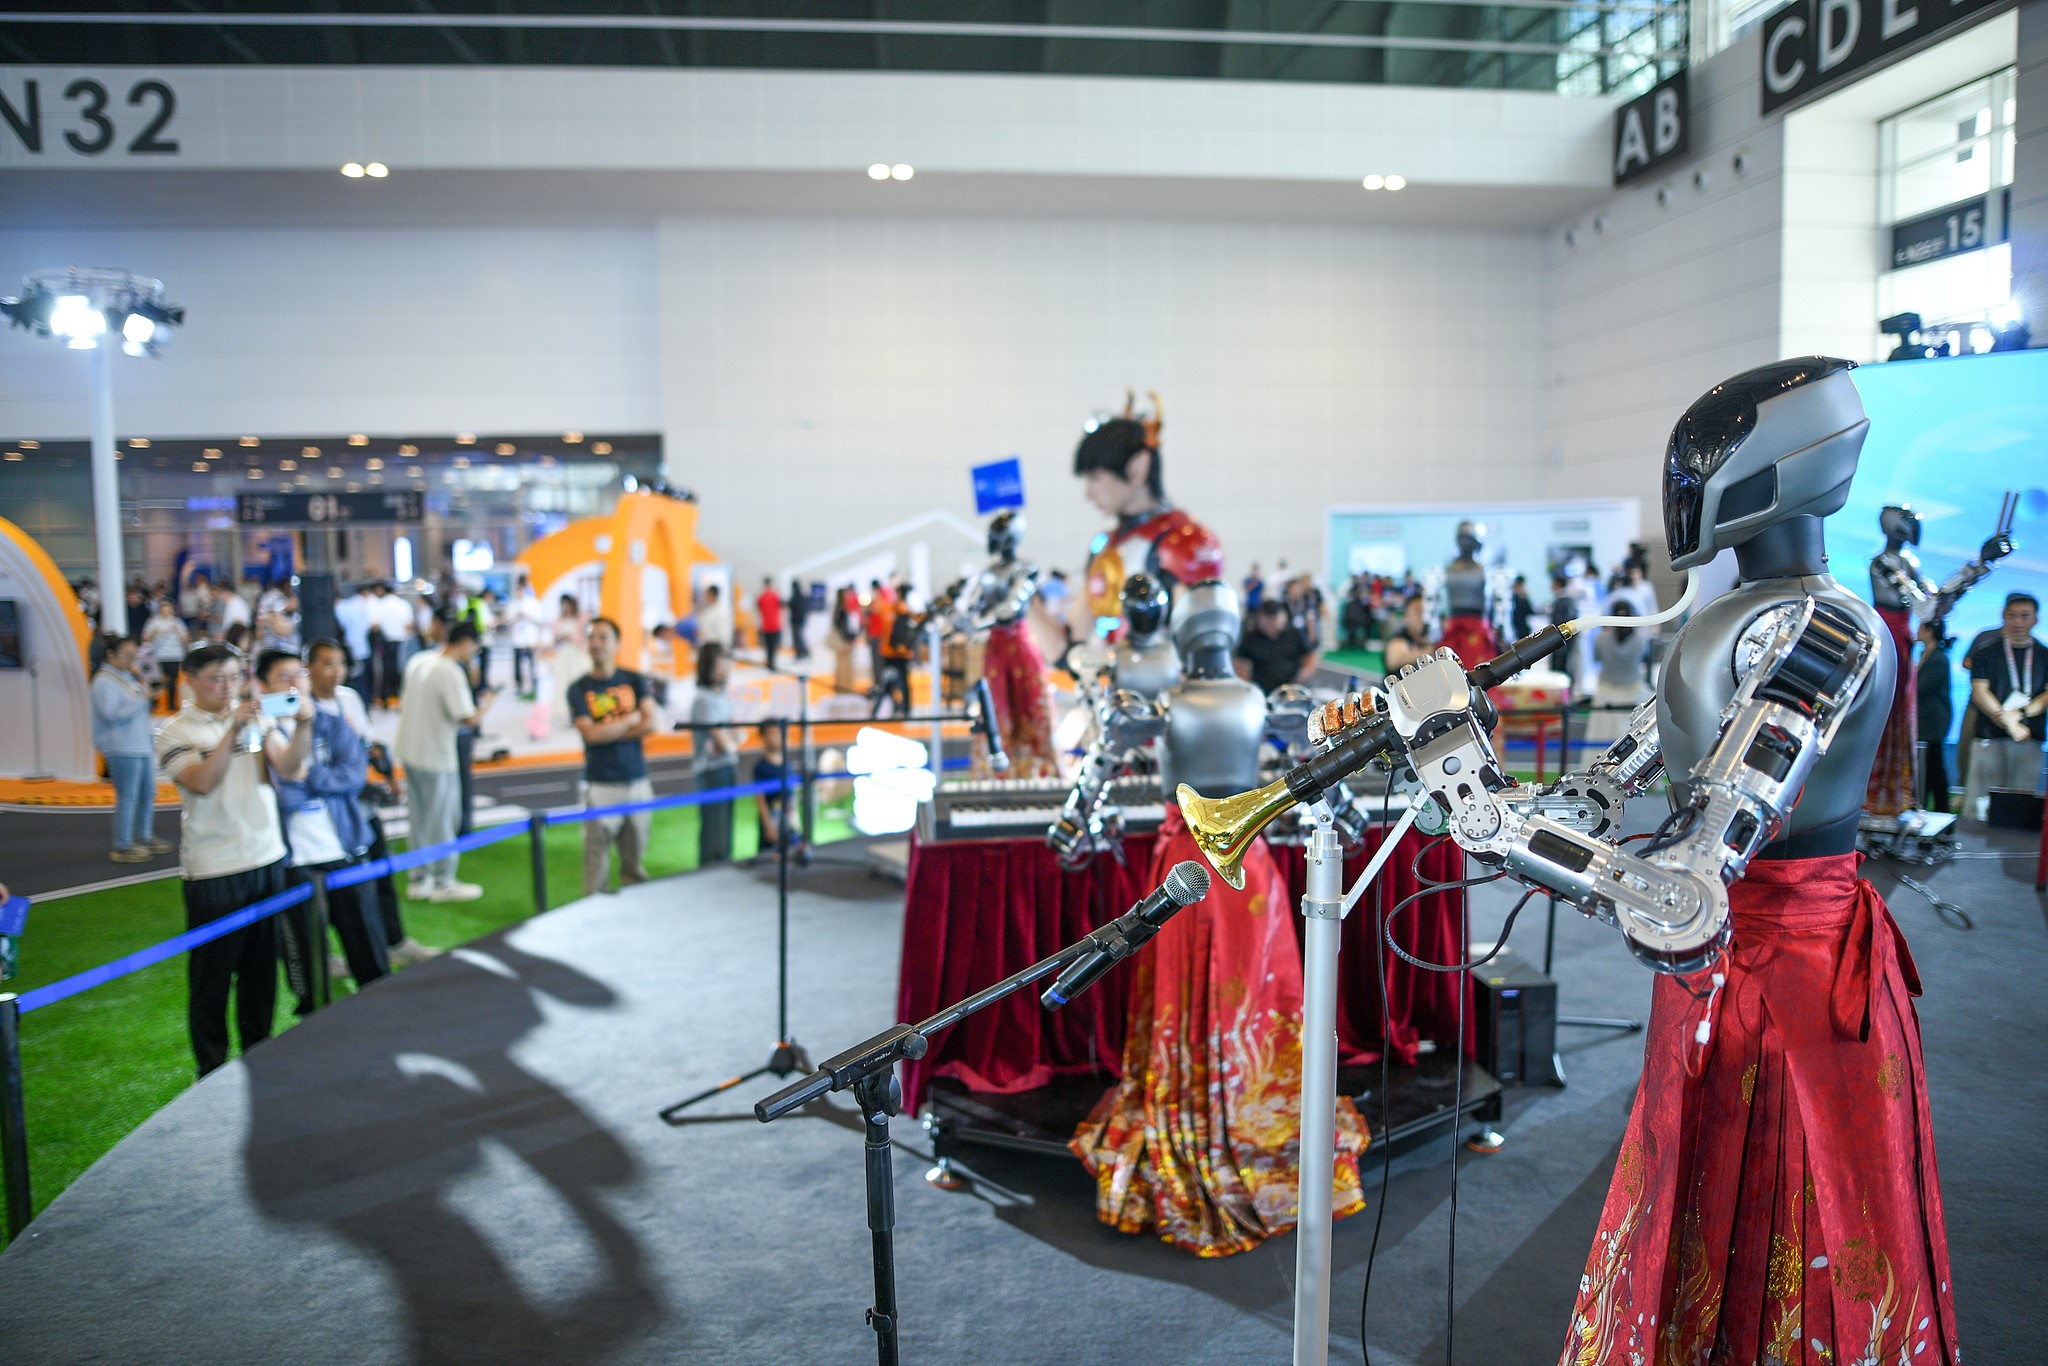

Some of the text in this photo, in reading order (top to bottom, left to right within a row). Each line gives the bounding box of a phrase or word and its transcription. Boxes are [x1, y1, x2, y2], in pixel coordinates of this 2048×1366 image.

[0, 78, 180, 154] N32
[1617, 87, 1680, 175] AB
[1946, 208, 1982, 251] 15
